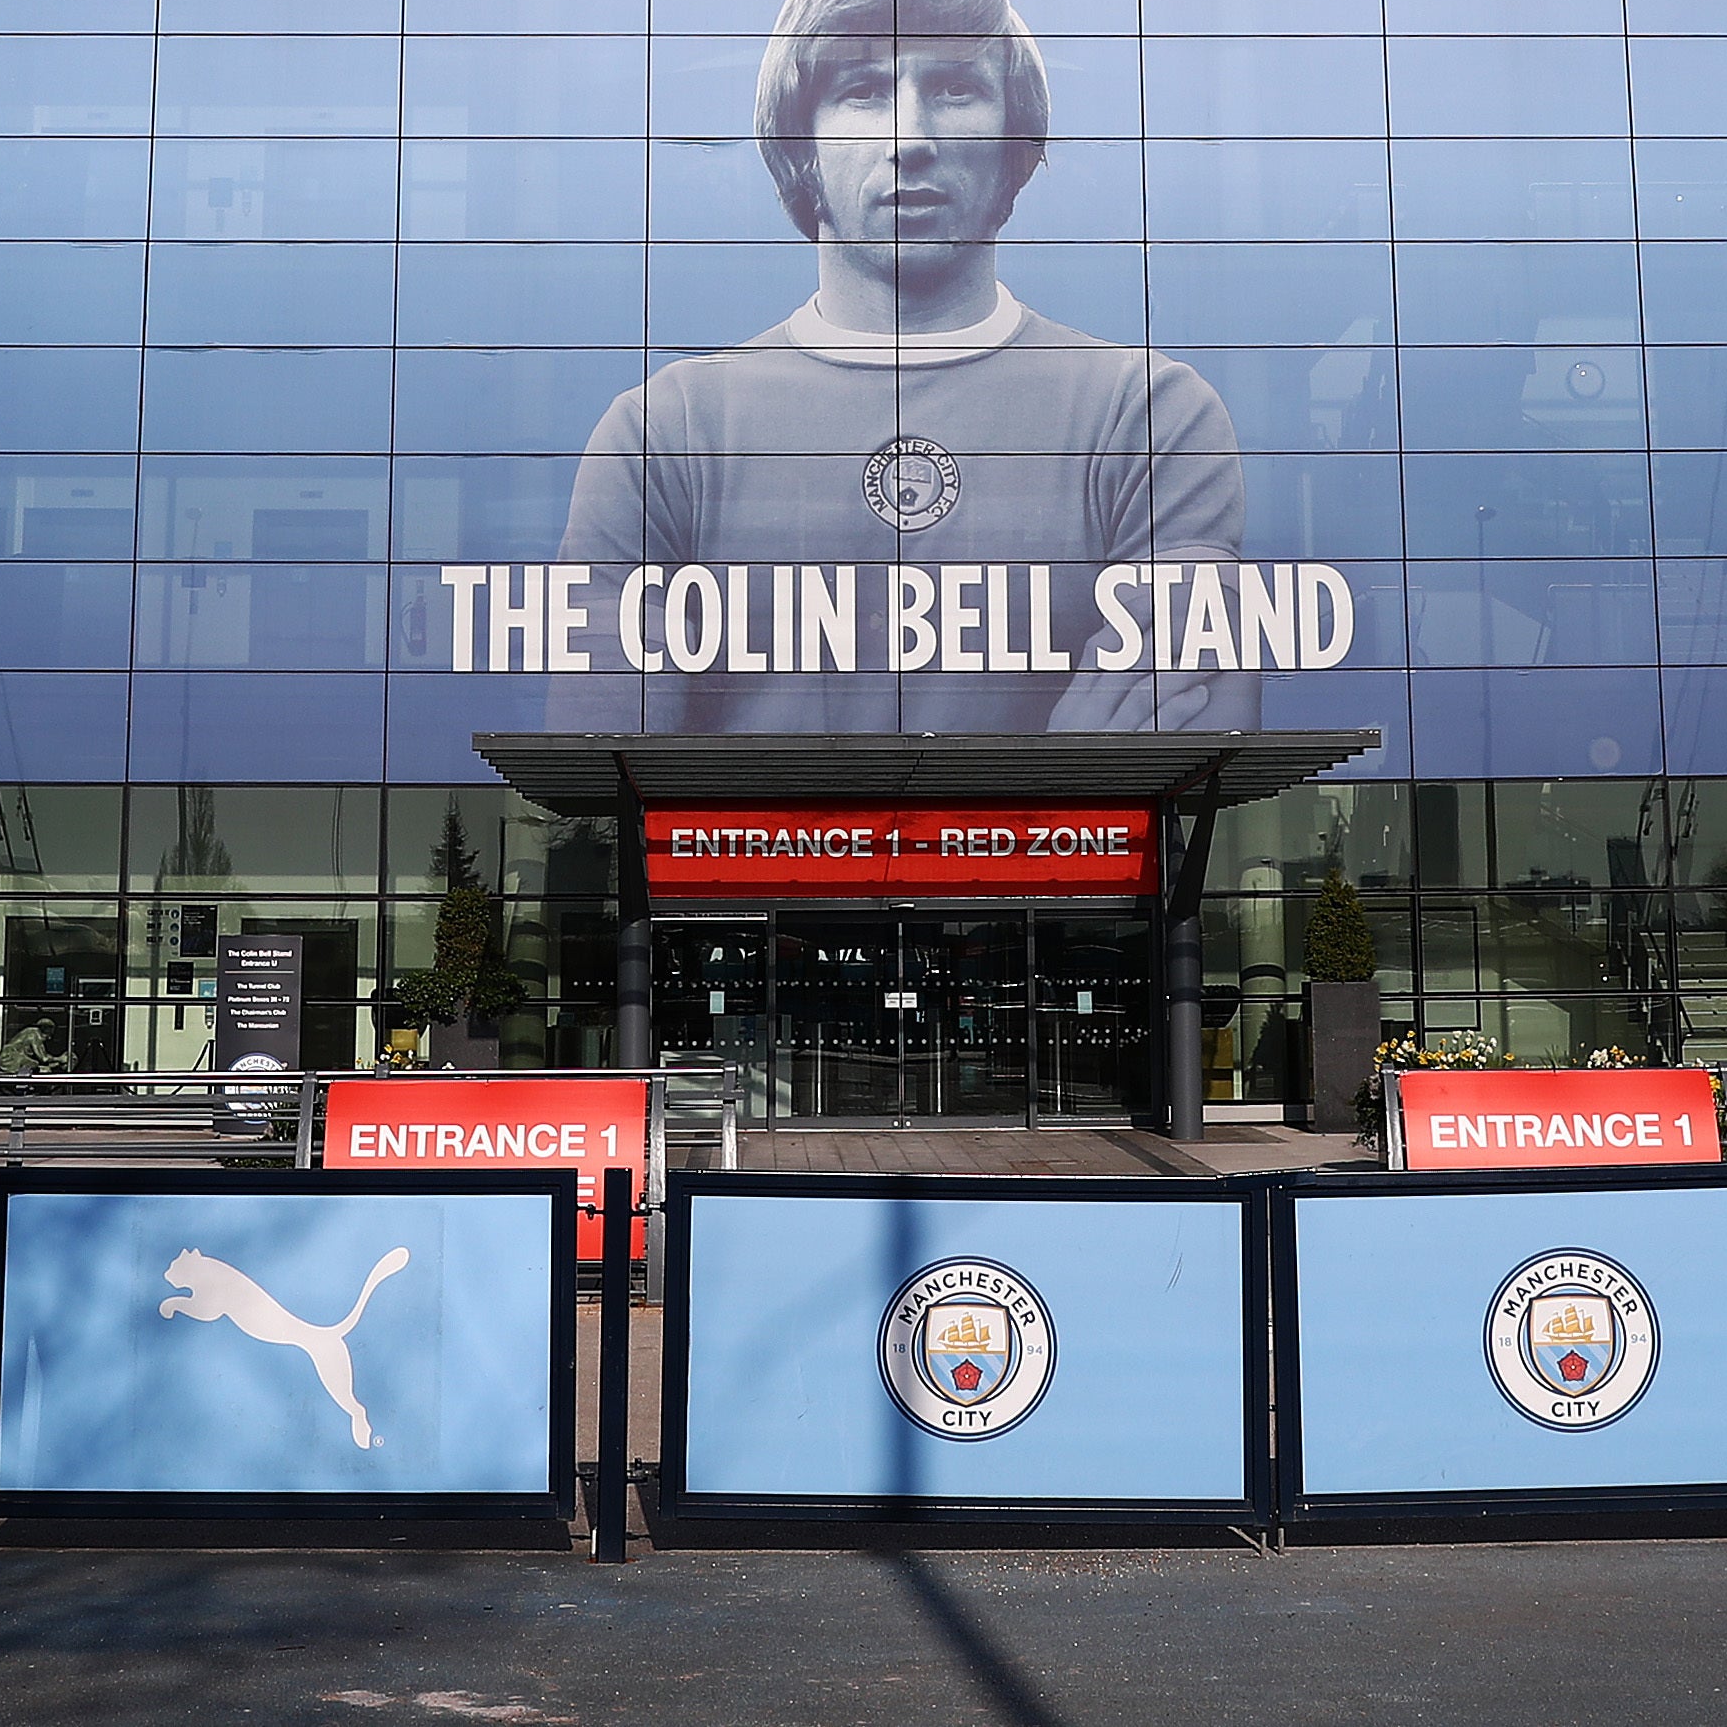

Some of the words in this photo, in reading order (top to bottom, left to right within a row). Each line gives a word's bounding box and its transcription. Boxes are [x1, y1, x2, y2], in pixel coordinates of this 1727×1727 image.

[937, 454, 958, 491] CITY
[441, 565, 591, 671] THE
[619, 565, 857, 671] COLIN
[888, 565, 1070, 671] BELL
[1094, 564, 1355, 671] STAND
[672, 828, 873, 857] ENTRANCE
[885, 829, 899, 857] 1
[941, 828, 1015, 857] RED
[1027, 827, 1130, 856] ZONE
[350, 1124, 586, 1158] ENTRANCE
[600, 1124, 617, 1157] 1
[1429, 1113, 1662, 1148] ENTRANCE
[1674, 1114, 1693, 1146] 1
[898, 1271, 1036, 1326] MANCHESTER
[1503, 1262, 1638, 1318] MANCHESTER
[893, 1343, 906, 1353] 18
[1026, 1345, 1043, 1355] 94
[1499, 1337, 1513, 1347] 18
[1630, 1333, 1647, 1344] 94
[942, 1410, 992, 1427] CITY
[1551, 1401, 1600, 1417] CITY
